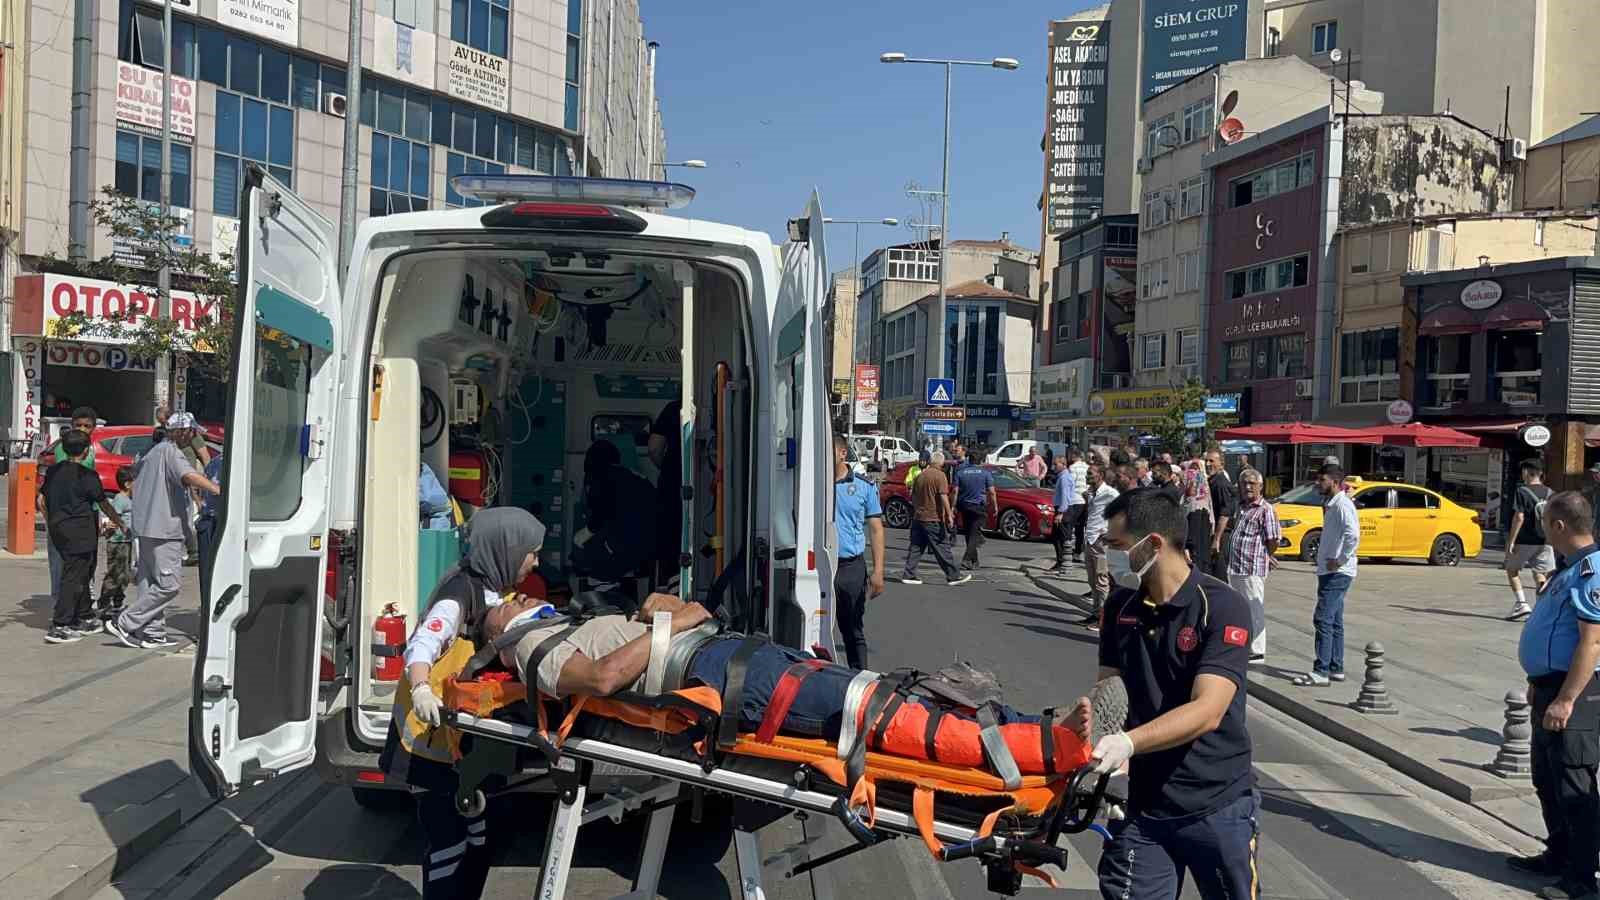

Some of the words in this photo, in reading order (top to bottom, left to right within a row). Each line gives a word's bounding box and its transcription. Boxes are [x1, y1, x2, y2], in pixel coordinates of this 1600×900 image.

[1154, 11, 1192, 29] SİEM
[1195, 4, 1238, 22] GRUP
[454, 46, 503, 72] AVUKAT
[1054, 46, 1072, 64] ASEL
[1075, 41, 1108, 63] AKADEMİ
[120, 66, 147, 85] SU
[1055, 66, 1069, 86] İLK
[1071, 69, 1105, 86] YARDIM
[119, 82, 192, 115] KIRALMA
[51, 346, 101, 366] OTO
[25, 390, 35, 440] PARK
